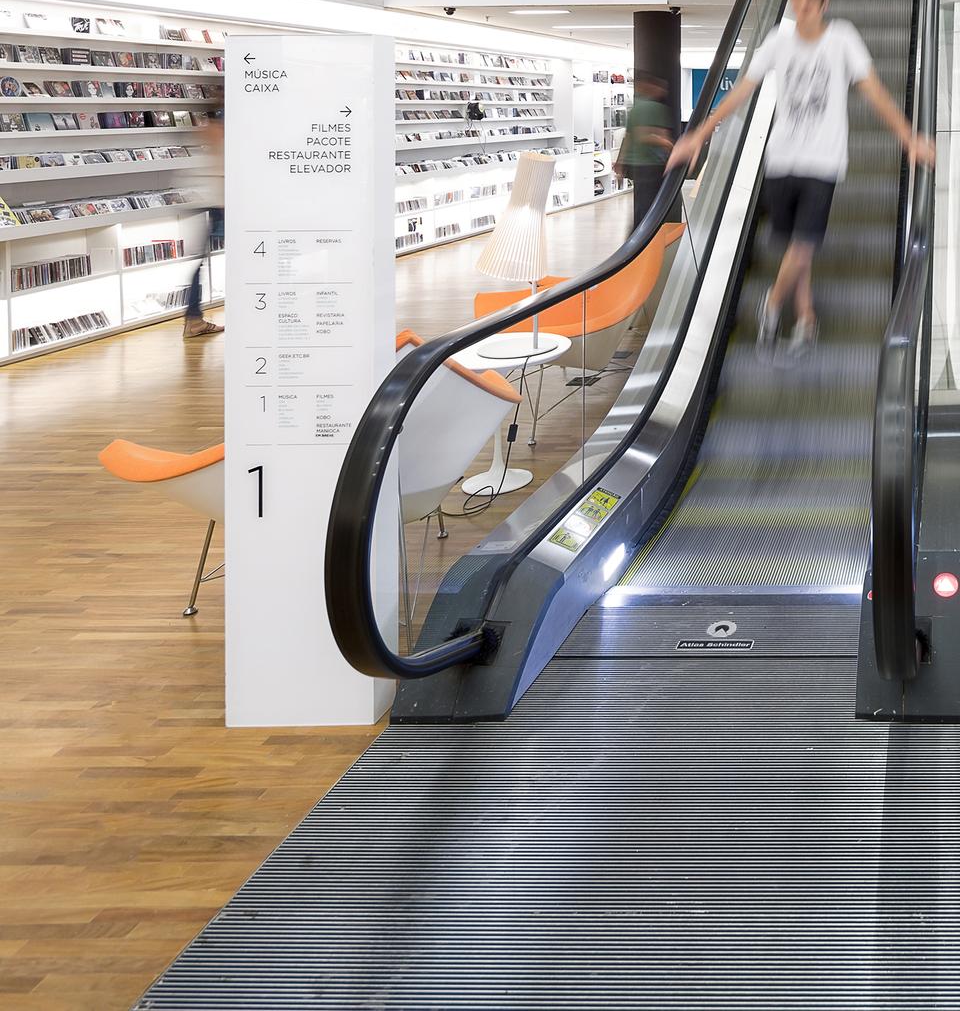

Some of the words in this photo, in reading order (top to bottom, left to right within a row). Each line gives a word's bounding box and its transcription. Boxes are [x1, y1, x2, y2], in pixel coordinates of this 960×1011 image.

[244, 68, 288, 80] MÚSICA
[244, 83, 280, 93] CAIXA
[311, 123, 352, 133] FILMES
[306, 137, 352, 146] PACOTE
[268, 150, 352, 160] RESTAURANTE
[289, 164, 352, 174] ELEVADOR
[253, 240, 267, 258] 4
[254, 292, 267, 311] 3
[255, 356, 267, 375] 2
[260, 395, 266, 413] 1
[247, 465, 264, 518] 1
